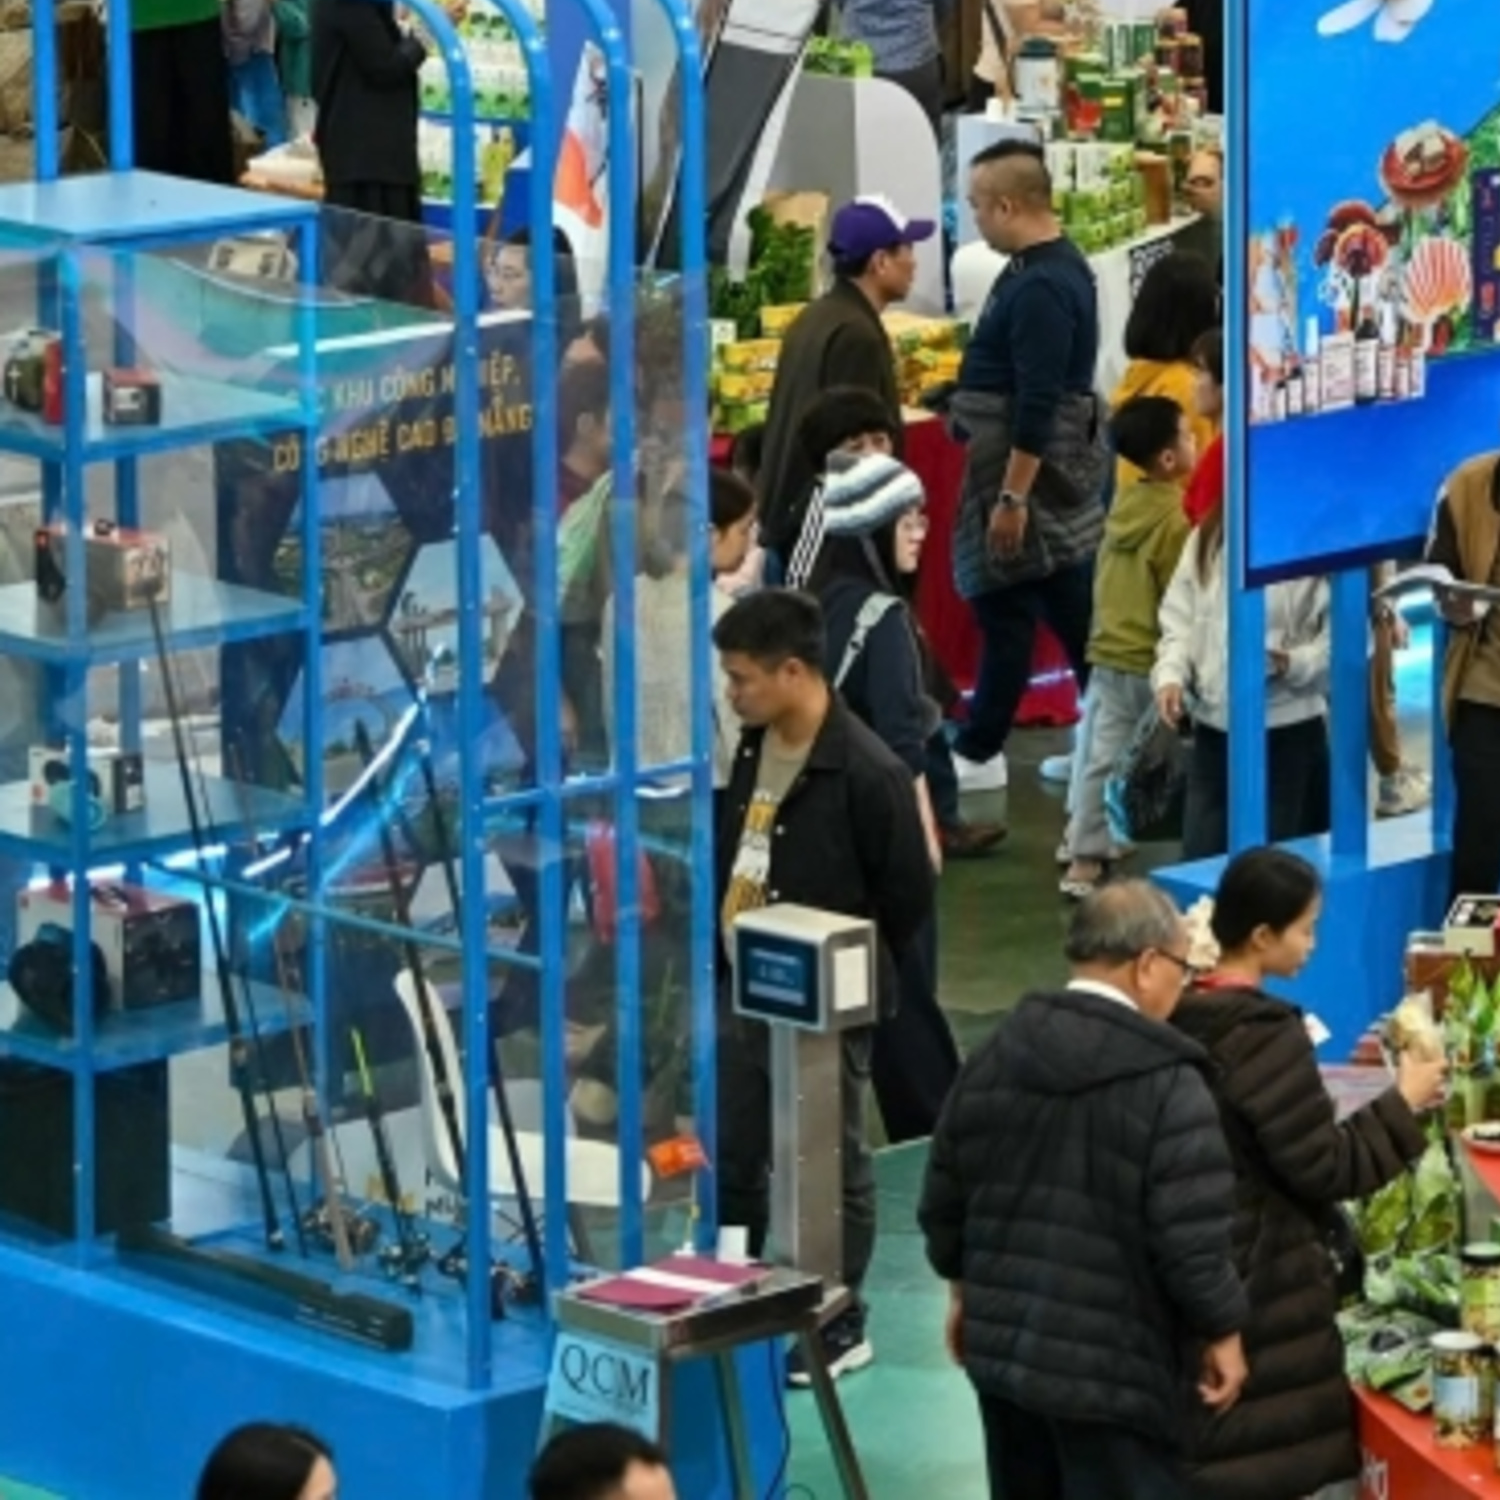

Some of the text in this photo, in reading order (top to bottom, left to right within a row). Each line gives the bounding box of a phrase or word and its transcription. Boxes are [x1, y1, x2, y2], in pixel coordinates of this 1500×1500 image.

[380, 365, 434, 402] CÔNG
[273, 433, 328, 473] CÔG
[396, 418, 438, 451] CAO
[560, 1344, 650, 1407] QCM
